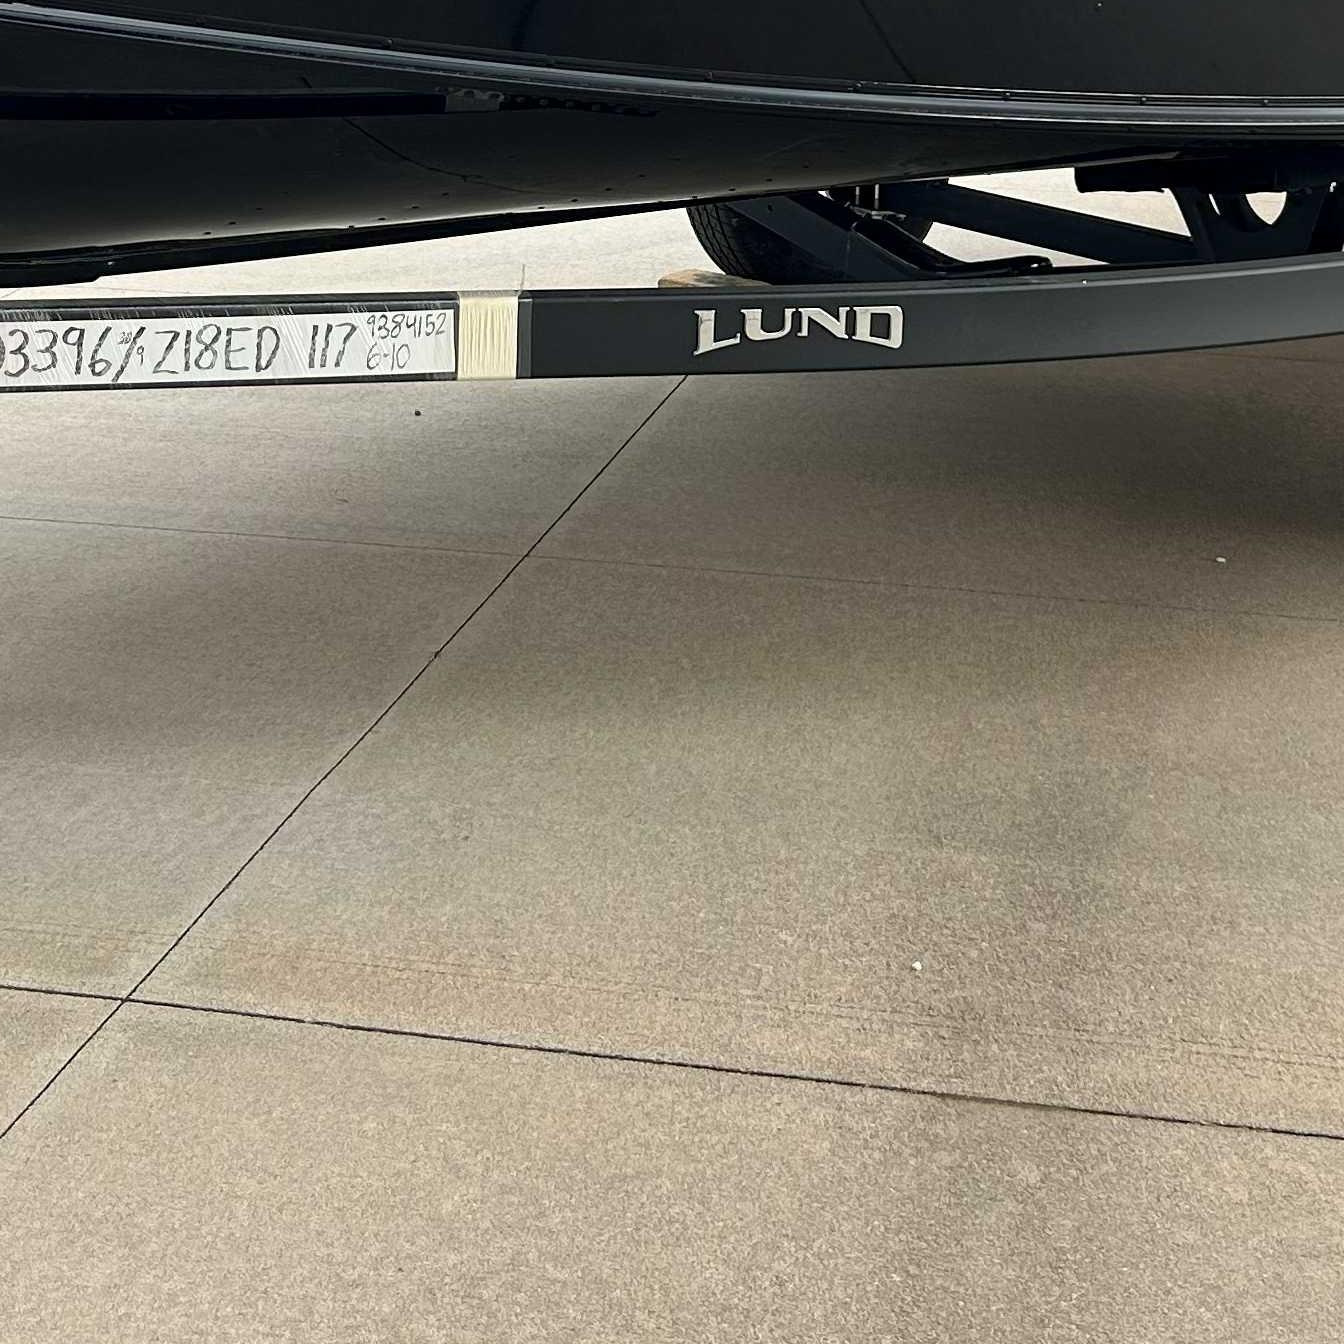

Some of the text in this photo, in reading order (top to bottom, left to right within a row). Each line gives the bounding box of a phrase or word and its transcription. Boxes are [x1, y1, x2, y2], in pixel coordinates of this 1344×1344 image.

[366, 312, 448, 339] 9384152
[693, 305, 904, 356] LUND
[366, 342, 411, 371] 6-10
